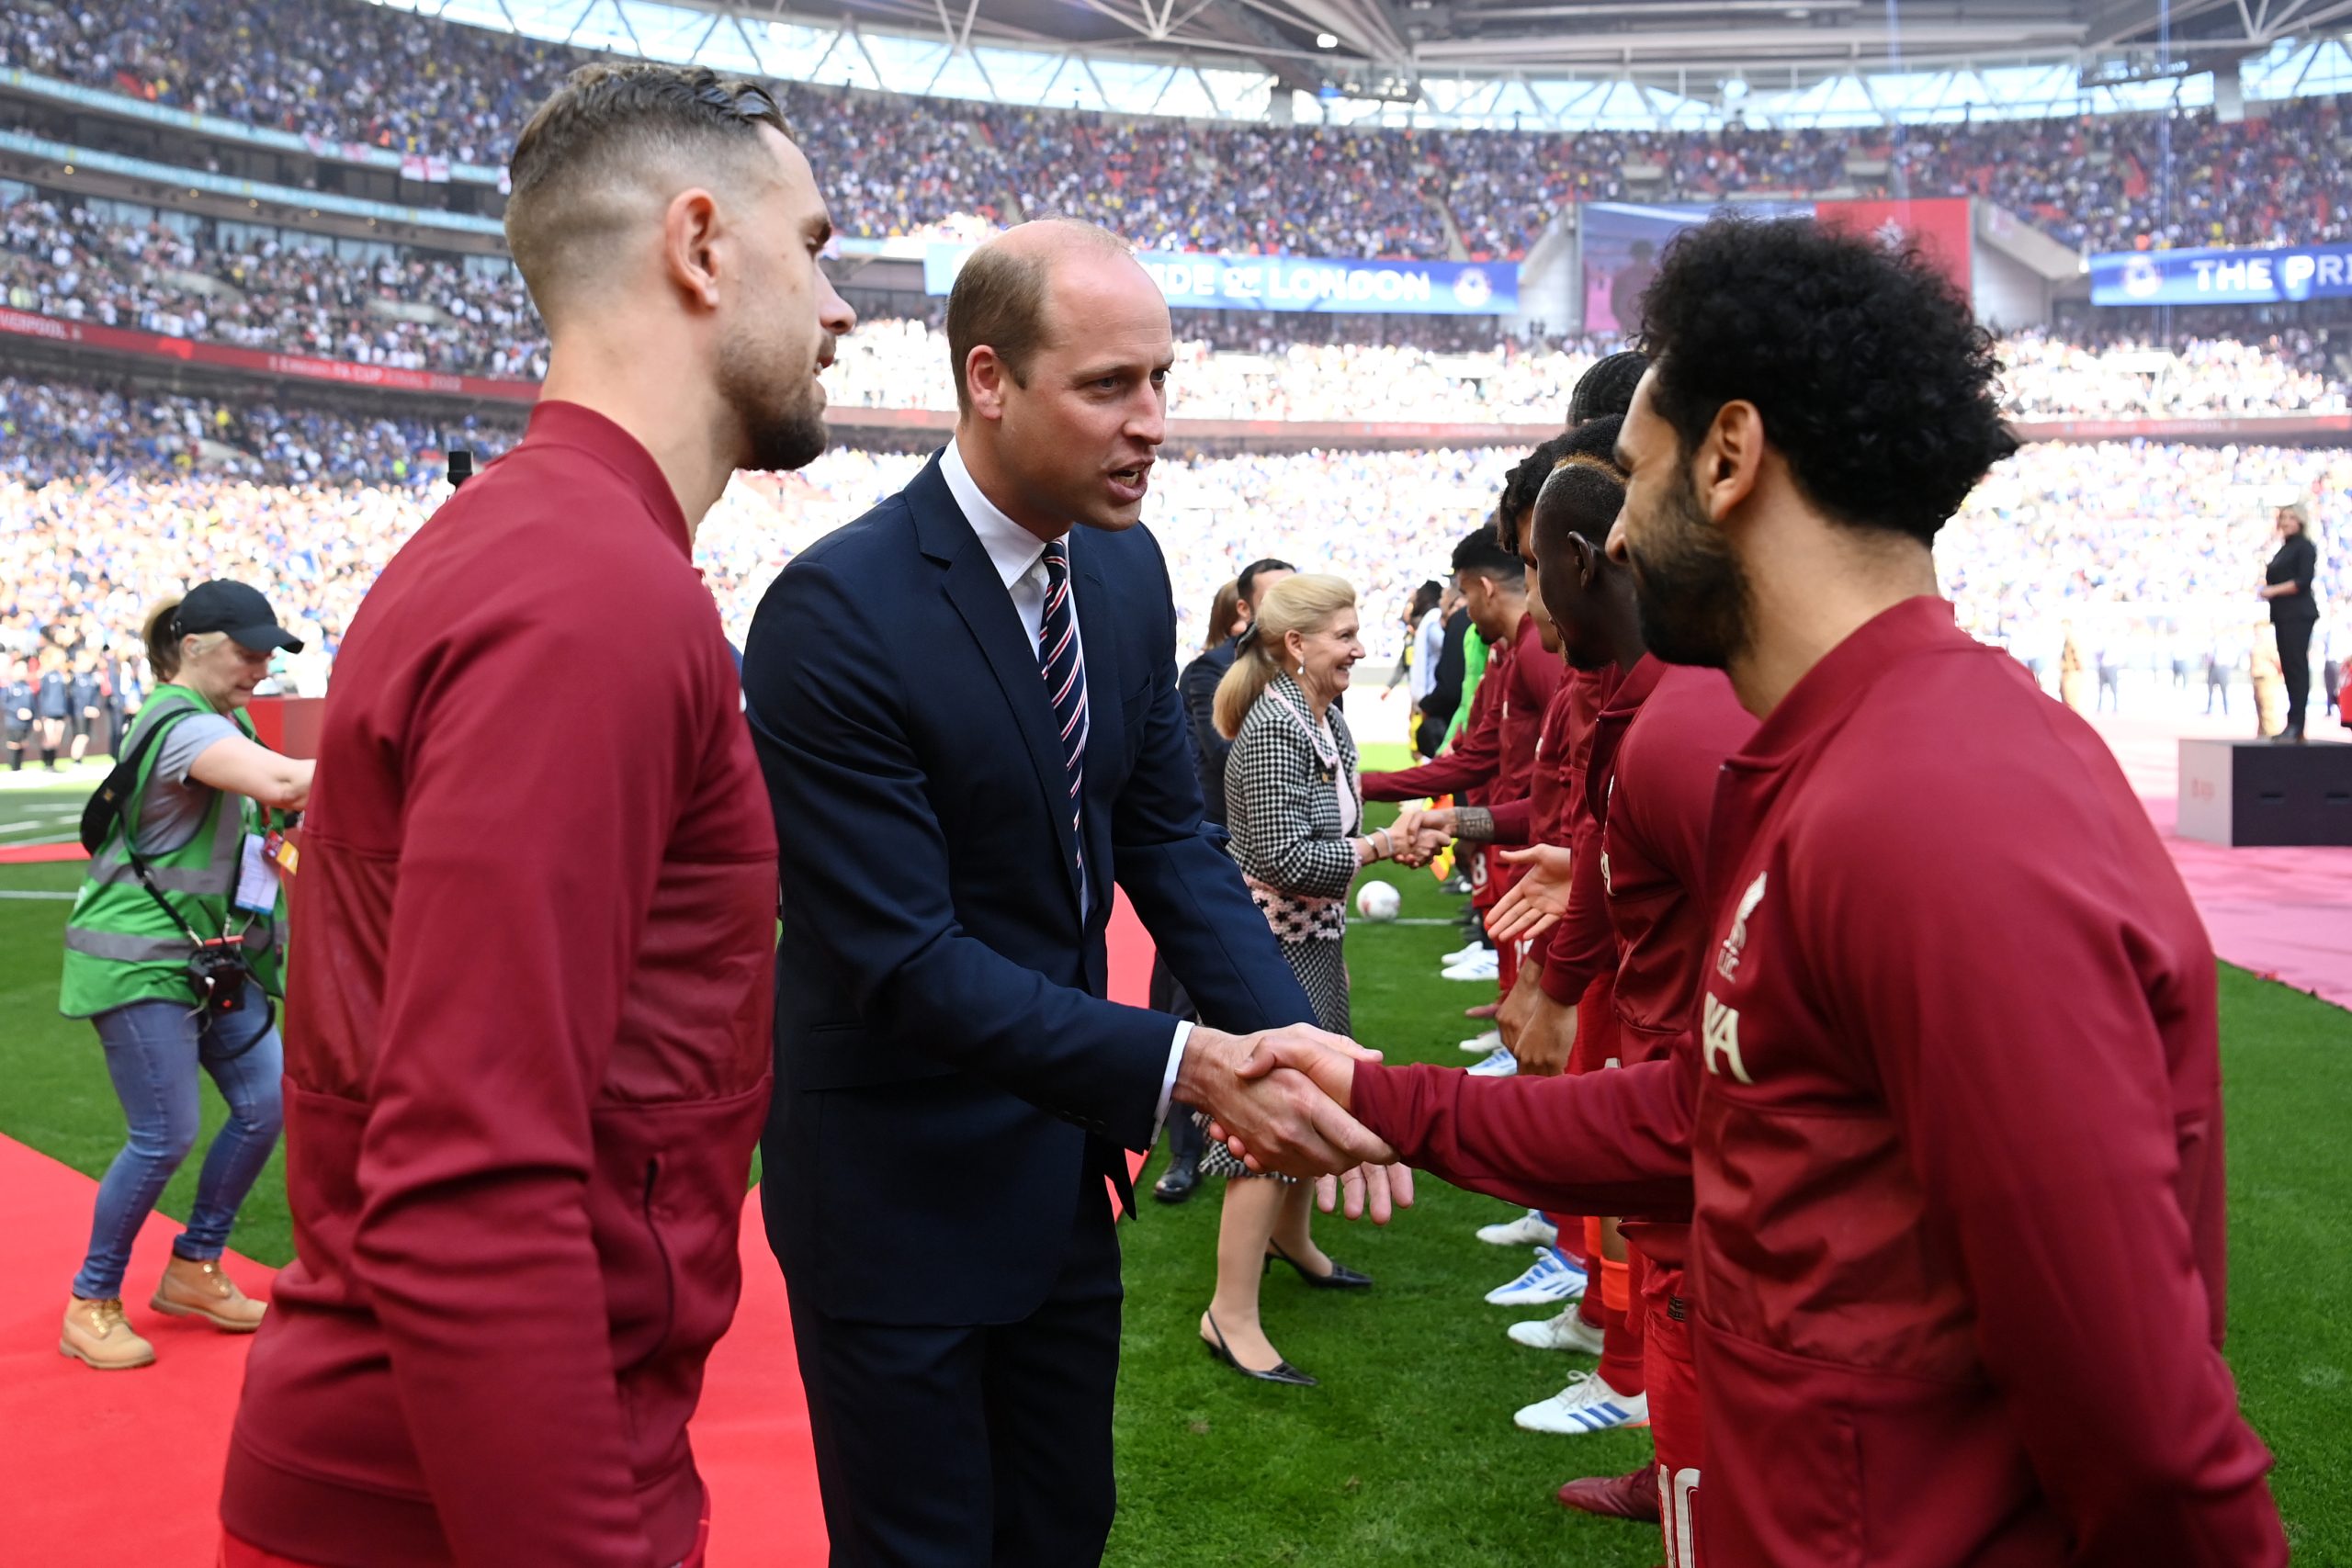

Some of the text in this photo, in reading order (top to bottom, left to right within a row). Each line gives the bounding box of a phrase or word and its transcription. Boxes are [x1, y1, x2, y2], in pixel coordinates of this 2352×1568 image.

[1147, 264, 1216, 295] IDE
[1269, 266, 1430, 300] LONDON
[2189, 258, 2273, 291] THE
